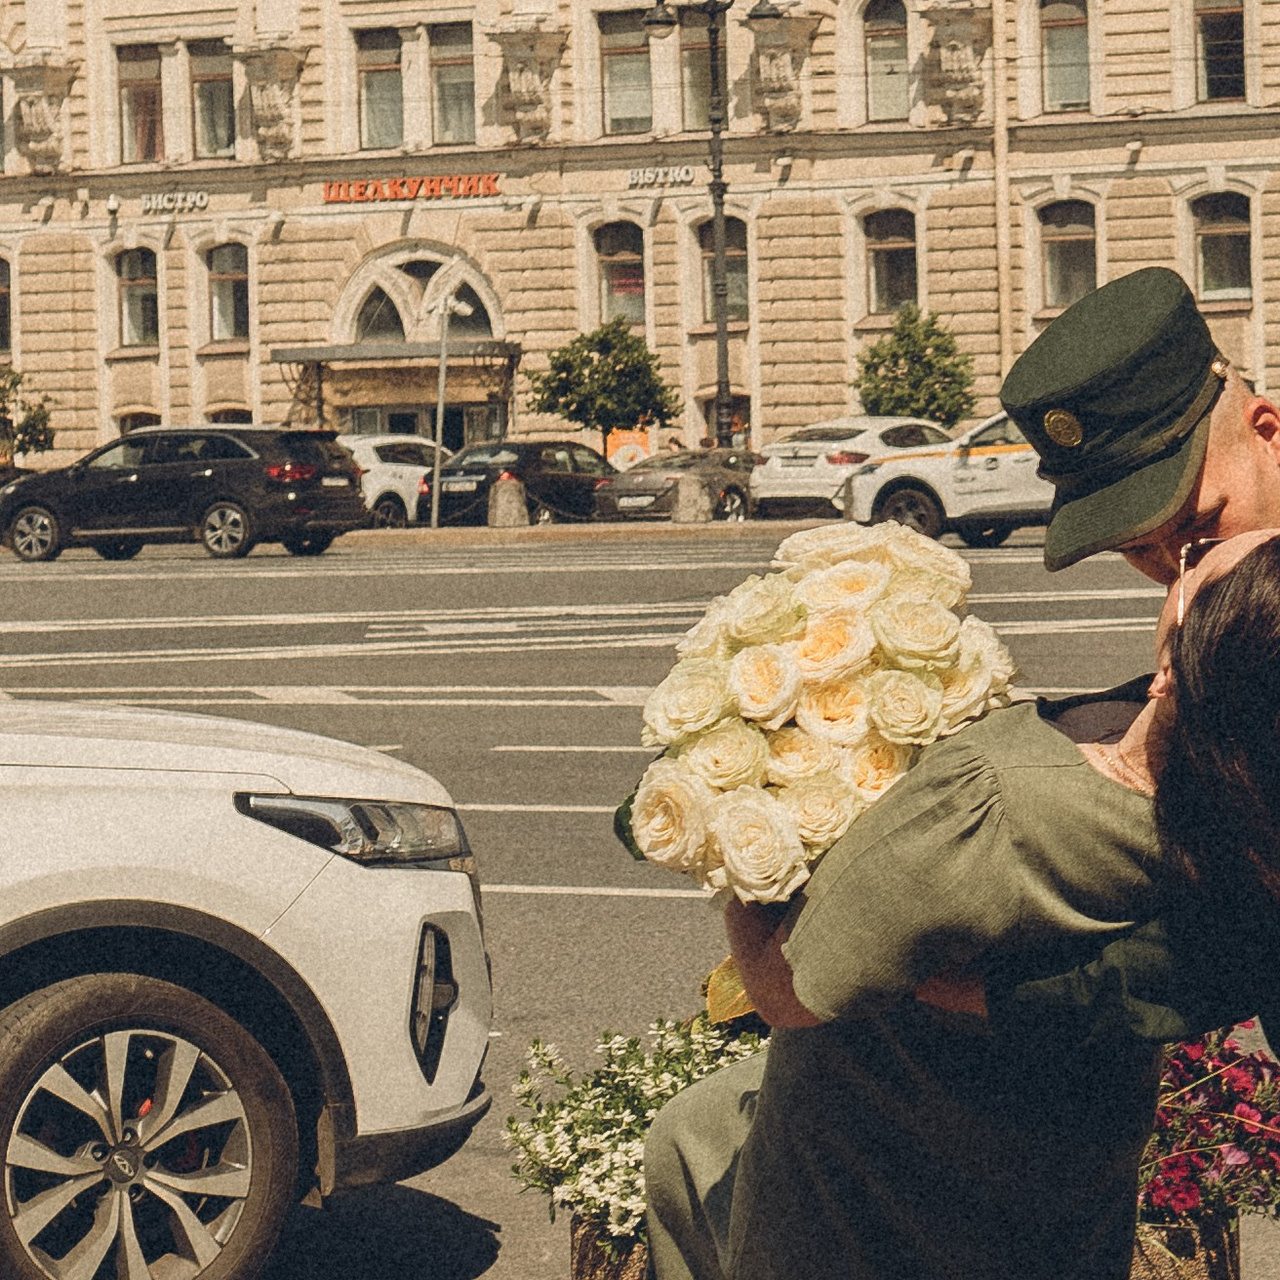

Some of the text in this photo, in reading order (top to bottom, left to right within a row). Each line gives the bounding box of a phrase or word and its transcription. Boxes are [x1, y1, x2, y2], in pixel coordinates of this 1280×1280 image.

[628, 165, 695, 184] BISTRO
[323, 173, 501, 203] ЩЕЛКУНЧИК
[141, 191, 209, 210] БИСТРО
